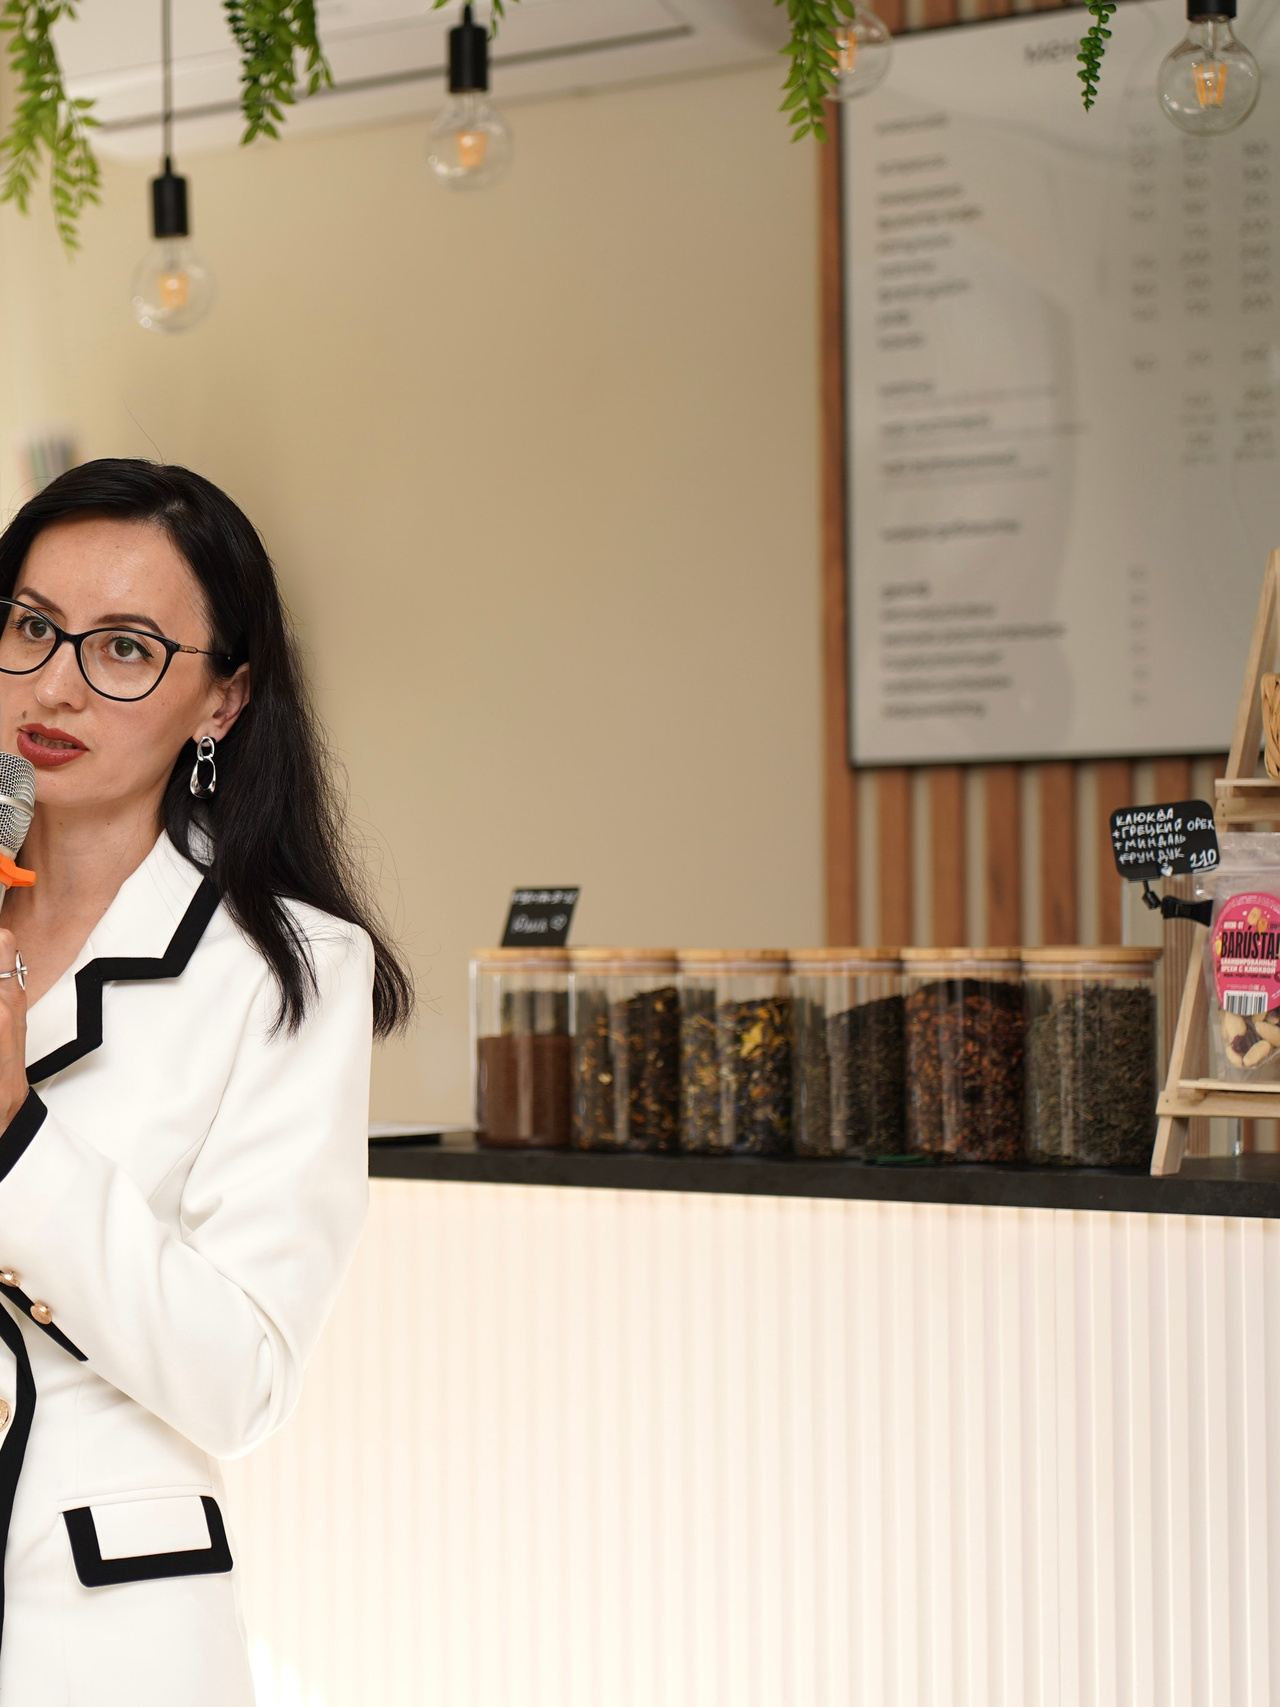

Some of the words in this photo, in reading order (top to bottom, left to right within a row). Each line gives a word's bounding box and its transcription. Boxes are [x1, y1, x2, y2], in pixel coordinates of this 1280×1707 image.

[1116, 807, 1174, 826] КЛЮКВА
[1186, 817, 1215, 831] ОРЕХ
[1189, 848, 1217, 868] 210
[1221, 925, 1280, 960] BARÚSTA!
